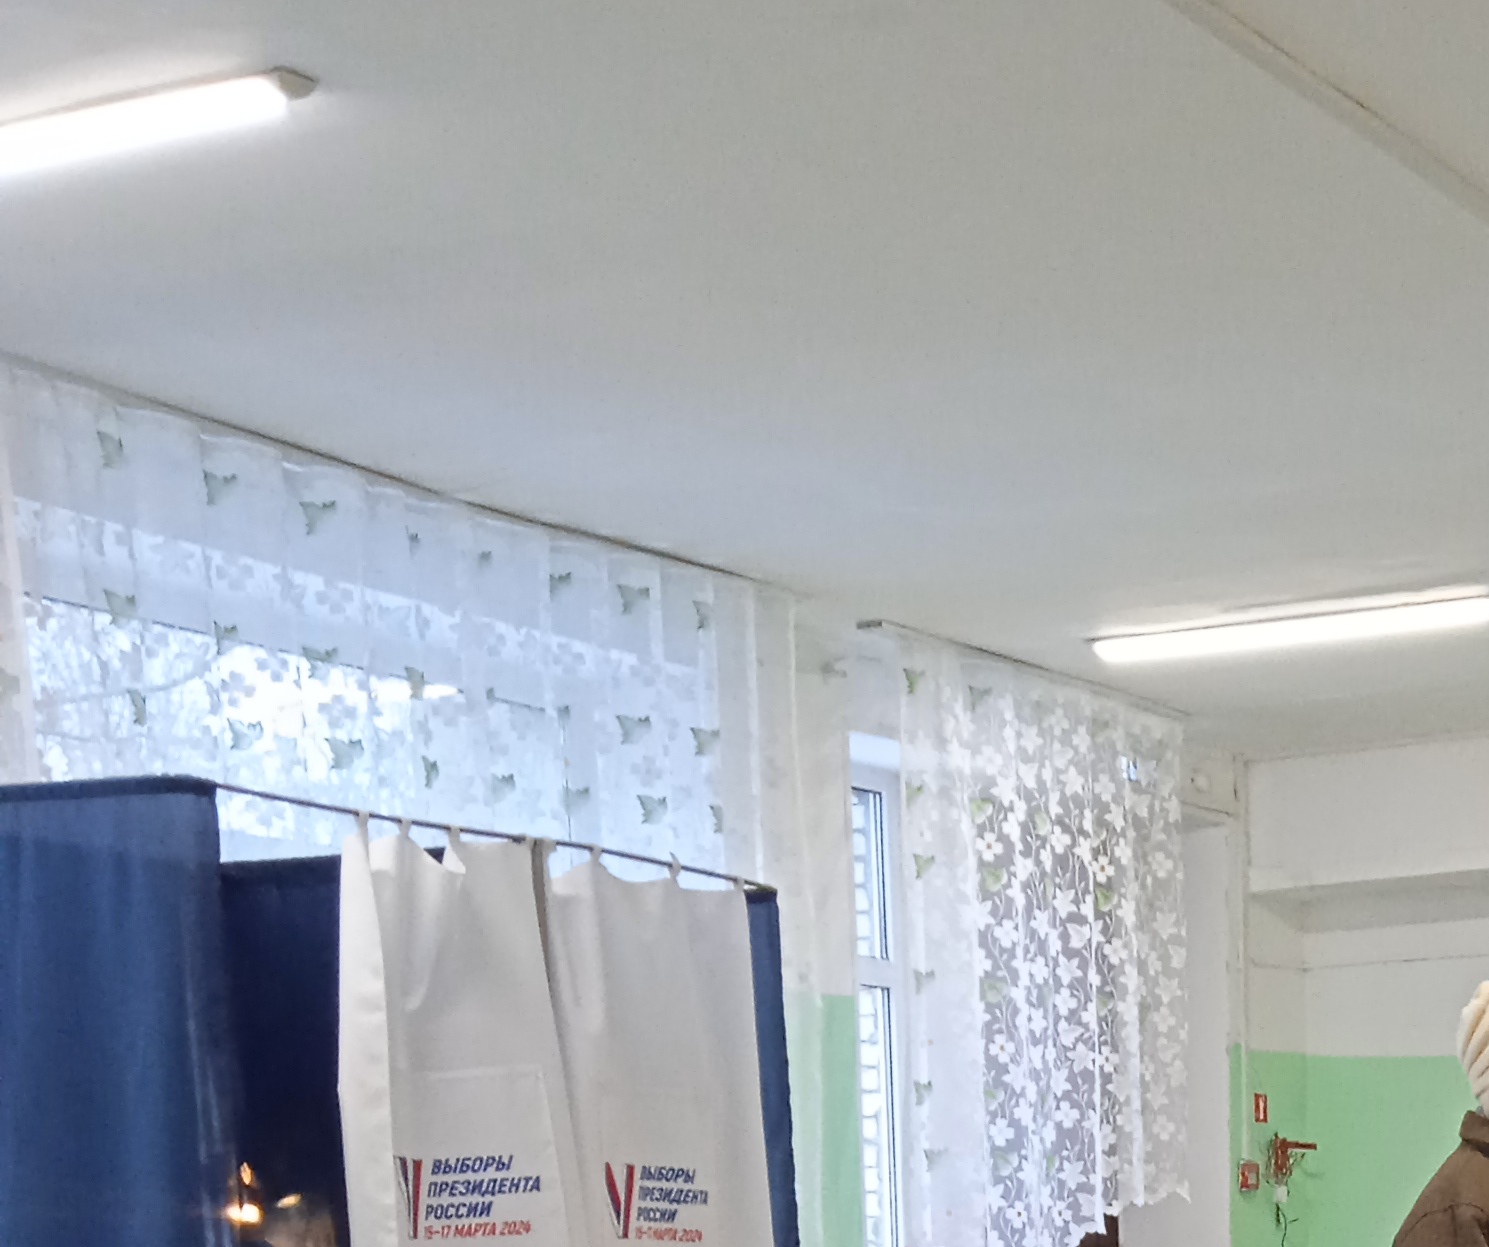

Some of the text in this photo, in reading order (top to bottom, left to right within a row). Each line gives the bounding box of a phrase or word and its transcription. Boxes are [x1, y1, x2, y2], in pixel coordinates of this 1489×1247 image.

[430, 1155, 513, 1175] ВЫБОРЫ
[640, 1165, 696, 1184] ВЫБОРЫ
[427, 1175, 542, 1198] ПРЕЗИДЕНТА
[424, 1201, 493, 1221] РОССИИ
[453, 1222, 497, 1237] МАРТА
[499, 1220, 532, 1235] 2024
